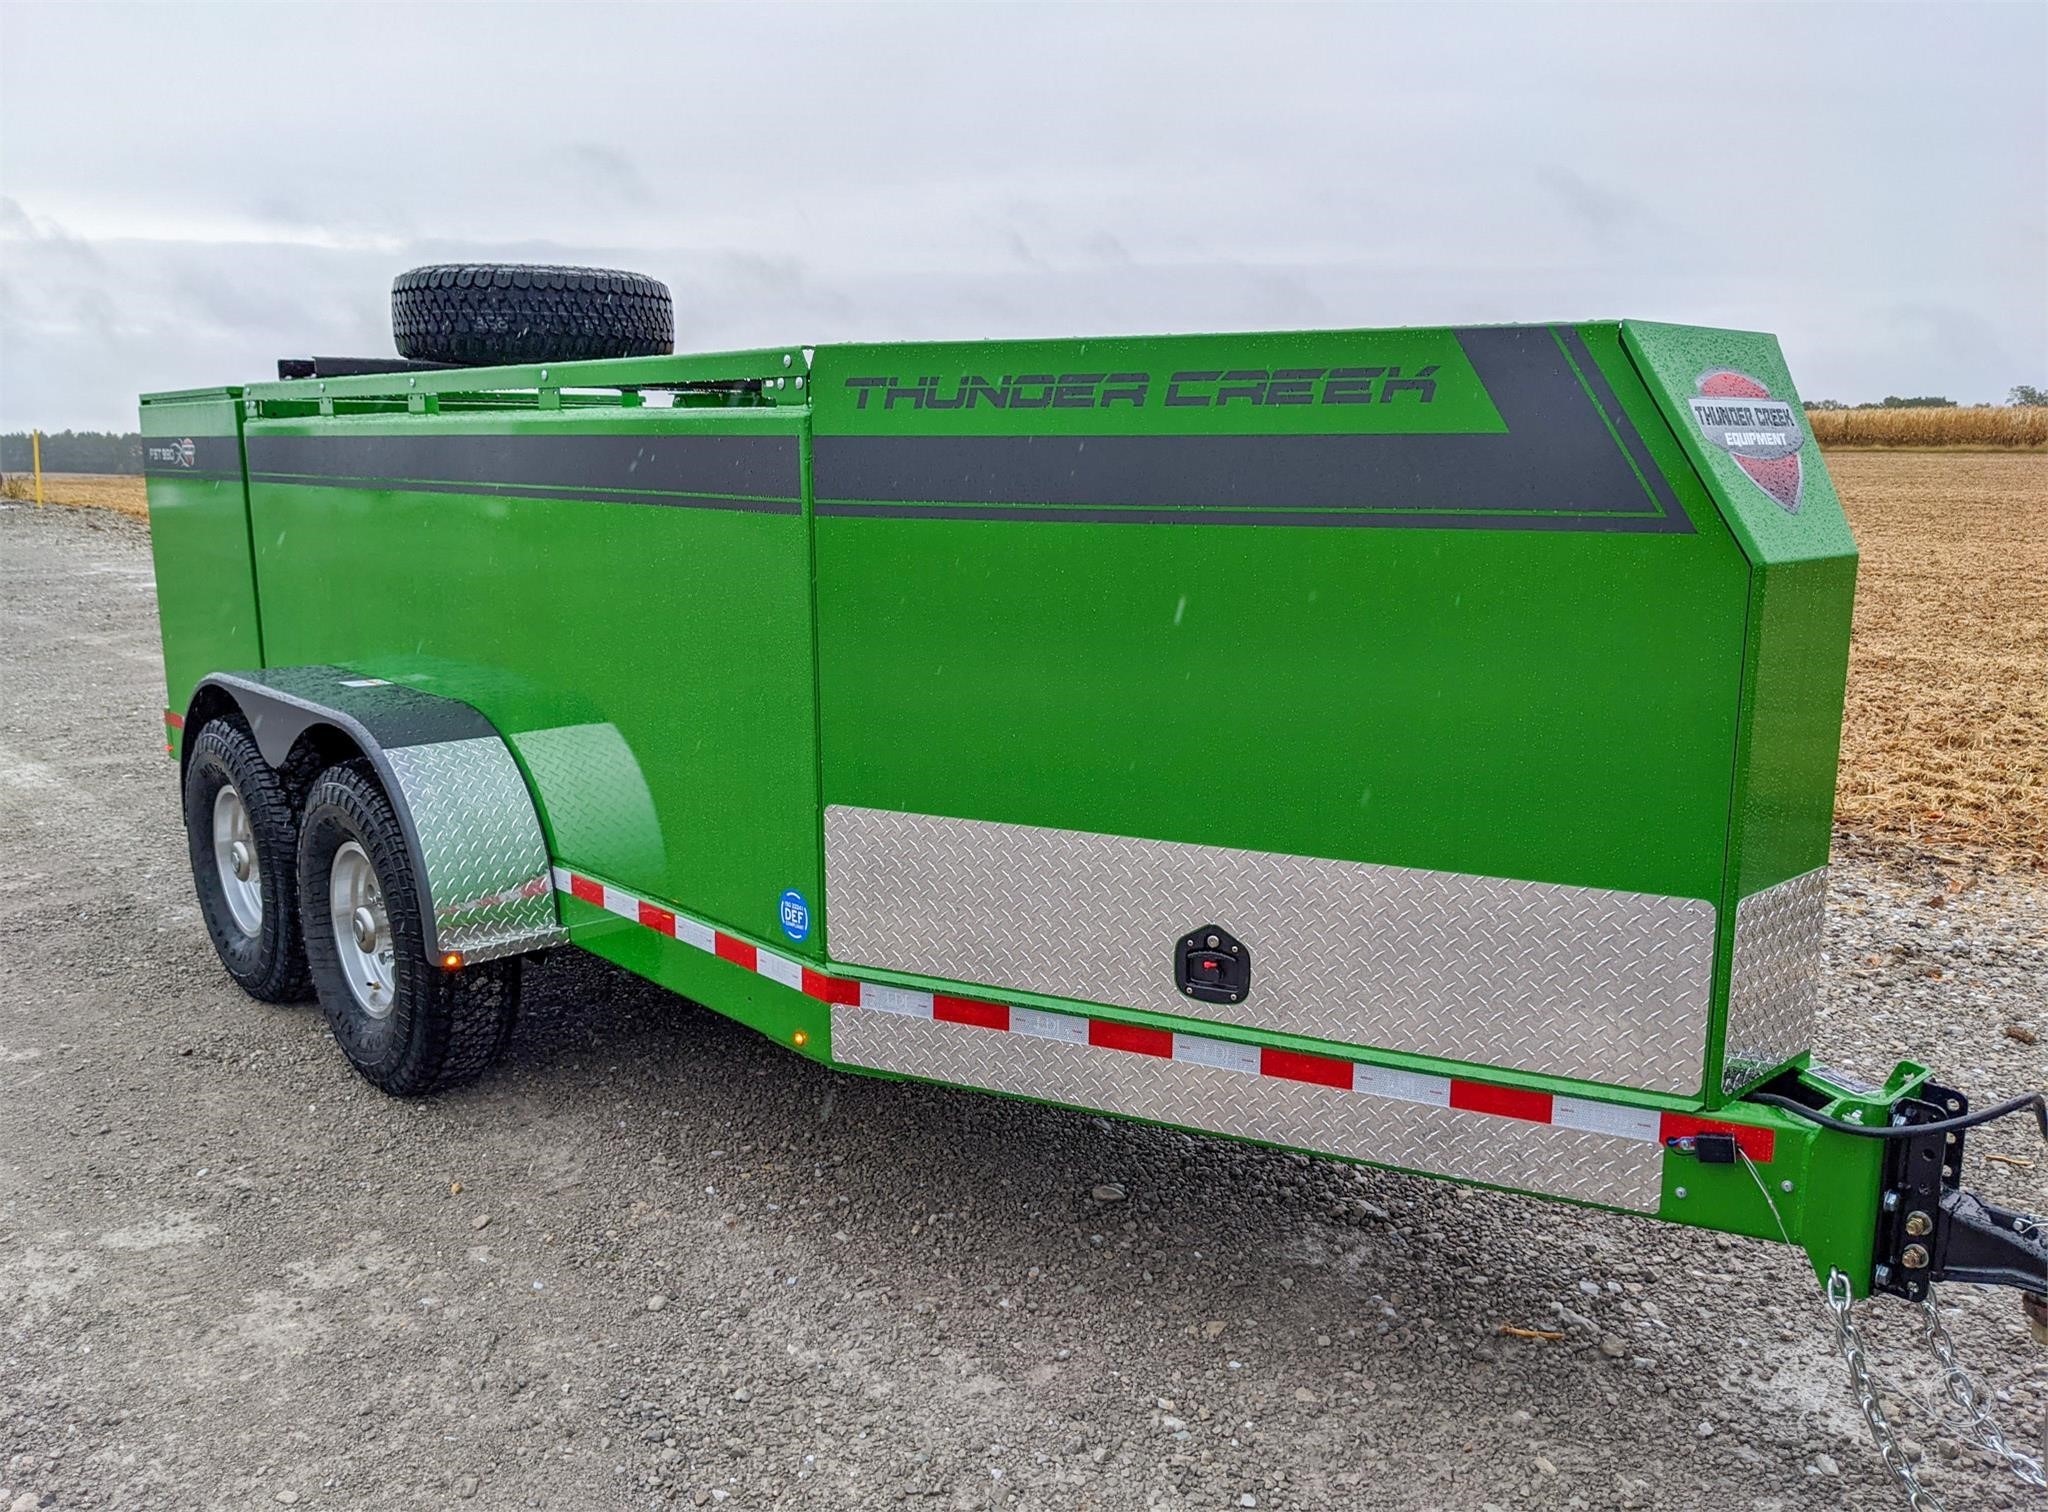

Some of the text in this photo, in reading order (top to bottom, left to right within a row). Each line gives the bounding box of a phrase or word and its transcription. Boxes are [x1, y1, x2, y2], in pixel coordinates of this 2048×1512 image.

[844, 365, 1441, 409] THUNDER CREEK
[1694, 406, 1795, 427] THUNDER CREEK
[1724, 432, 1788, 447] EQUIPMENT
[784, 907, 804, 924] DEF
